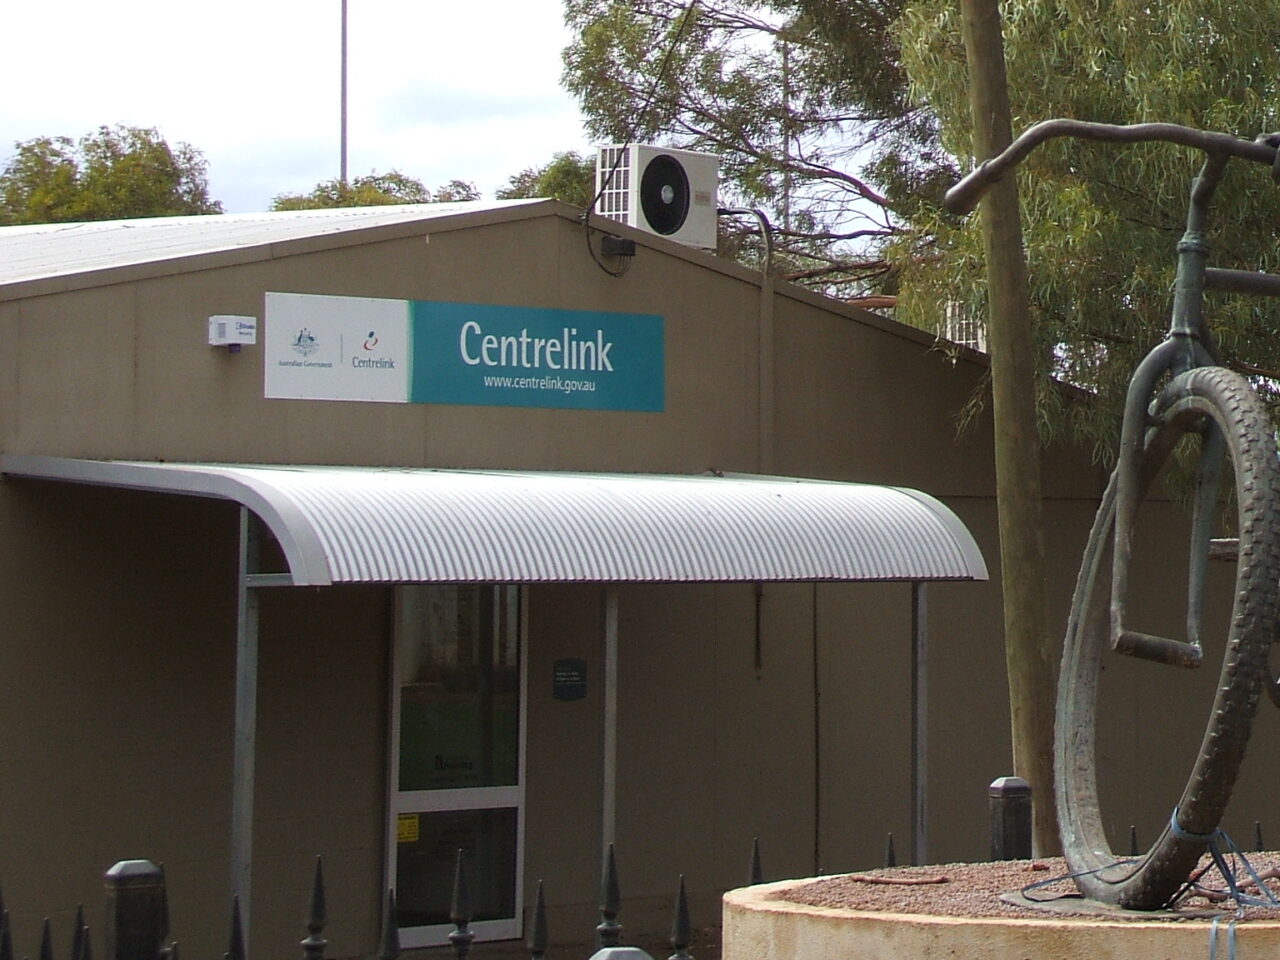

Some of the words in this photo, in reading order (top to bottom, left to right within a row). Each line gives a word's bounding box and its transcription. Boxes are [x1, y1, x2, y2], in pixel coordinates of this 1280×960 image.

[460, 321, 614, 371] Centrelink
[352, 356, 395, 369] Centrelink
[484, 375, 596, 394] www.centrelink.gov.au
